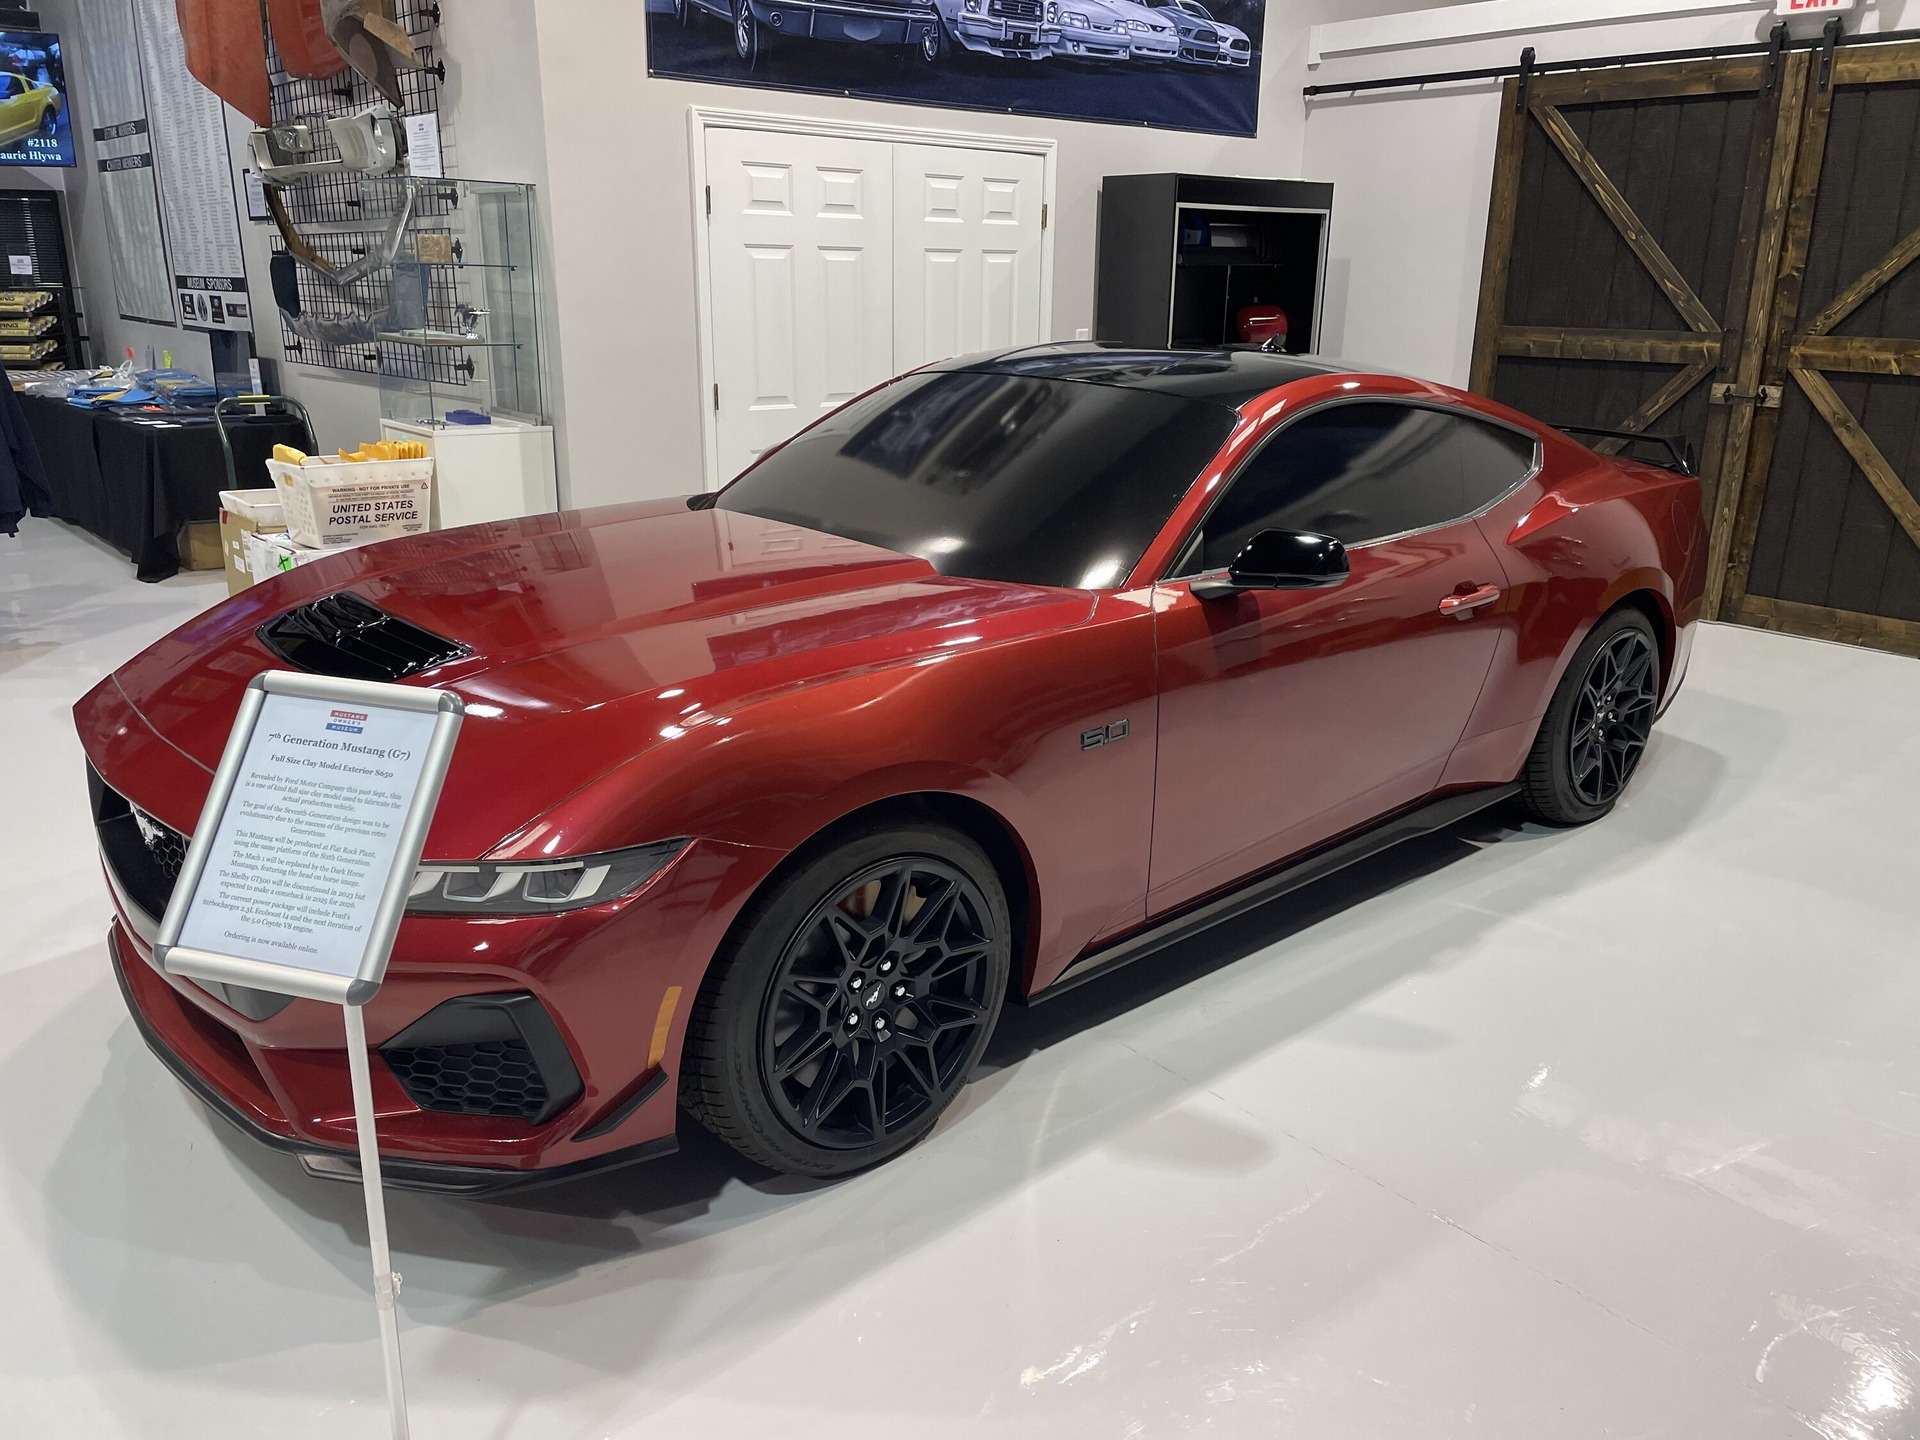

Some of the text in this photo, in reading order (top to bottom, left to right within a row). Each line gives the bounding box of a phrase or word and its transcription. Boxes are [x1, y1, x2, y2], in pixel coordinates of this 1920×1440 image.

[27, 138, 58, 148] #2118
[0, 151, 62, 162] aurie Hlywa
[329, 510, 418, 526] POSTAL SERVICE
[332, 500, 413, 514] UNITED STATES
[333, 711, 365, 719] MUSTANG
[331, 724, 358, 732] MUSEUM
[1081, 718, 1129, 751] 5.0
[268, 733, 410, 760] 7th Generation Mustang (G7)
[271, 754, 285, 762] Full
[302, 759, 318, 768] Clay
[319, 761, 342, 770] Model
[343, 765, 374, 775] Exterior
[374, 769, 393, 778] S650
[251, 772, 276, 781] Revealed
[276, 775, 284, 783] by
[299, 779, 317, 787] Motor
[318, 782, 345, 793] Company
[390, 792, 401, 800] this
[273, 784, 287, 792] kind
[310, 790, 322, 798] clay
[364, 798, 390, 807] fabricate
[243, 800, 253, 808] The
[342, 816, 361, 825] design
[382, 821, 390, 829] be
[300, 799, 332, 808] production
[240, 811, 275, 821] evolutionary
[344, 827, 370, 835] previous
[234, 839, 250, 848] using
[276, 846, 301, 855] platform
[320, 852, 335, 861] Sixth
[336, 855, 370, 866] Generation.
[236, 829, 248, 837] This
[248, 832, 274, 843] Mustang
[293, 840, 322, 849] produced
[329, 844, 341, 852] Flat
[342, 847, 357, 855] Rock
[358, 849, 375, 858] Plant,
[233, 850, 244, 858] The
[244, 852, 260, 861] Mach
[277, 857, 285, 865] be
[285, 860, 311, 869] replaced
[311, 863, 319, 872] by
[330, 866, 345, 875] Dark
[346, 869, 364, 878] Horse
[260, 864, 287, 876] featuring
[298, 870, 313, 879] head
[322, 874, 339, 883] horse
[340, 877, 360, 887] image.
[220, 881, 246, 889] expected
[275, 890, 304, 899] comeback
[312, 896, 328, 905] 2025
[328, 897, 338, 905] for
[230, 872, 250, 882] Shelby
[250, 875, 271, 884] GT500
[283, 880, 291, 888] be
[292, 882, 330, 894] discontinued
[330, 888, 337, 896] in
[338, 891, 354, 899] 2023
[354, 892, 365, 900] but
[203, 899, 239, 911] turbocharges
[255, 907, 281, 918] Ecoboost
[327, 920, 353, 930] iteration
[219, 891, 230, 899] The
[230, 895, 252, 903] current
[271, 902, 295, 912] package
[296, 905, 308, 913] will
[308, 907, 330, 916] include
[241, 914, 251, 922] the
[261, 918, 282, 928] Coyote
[292, 925, 313, 933] engine.
[224, 931, 250, 942] Ordering
[271, 941, 297, 950] available
[298, 945, 317, 953] online.
